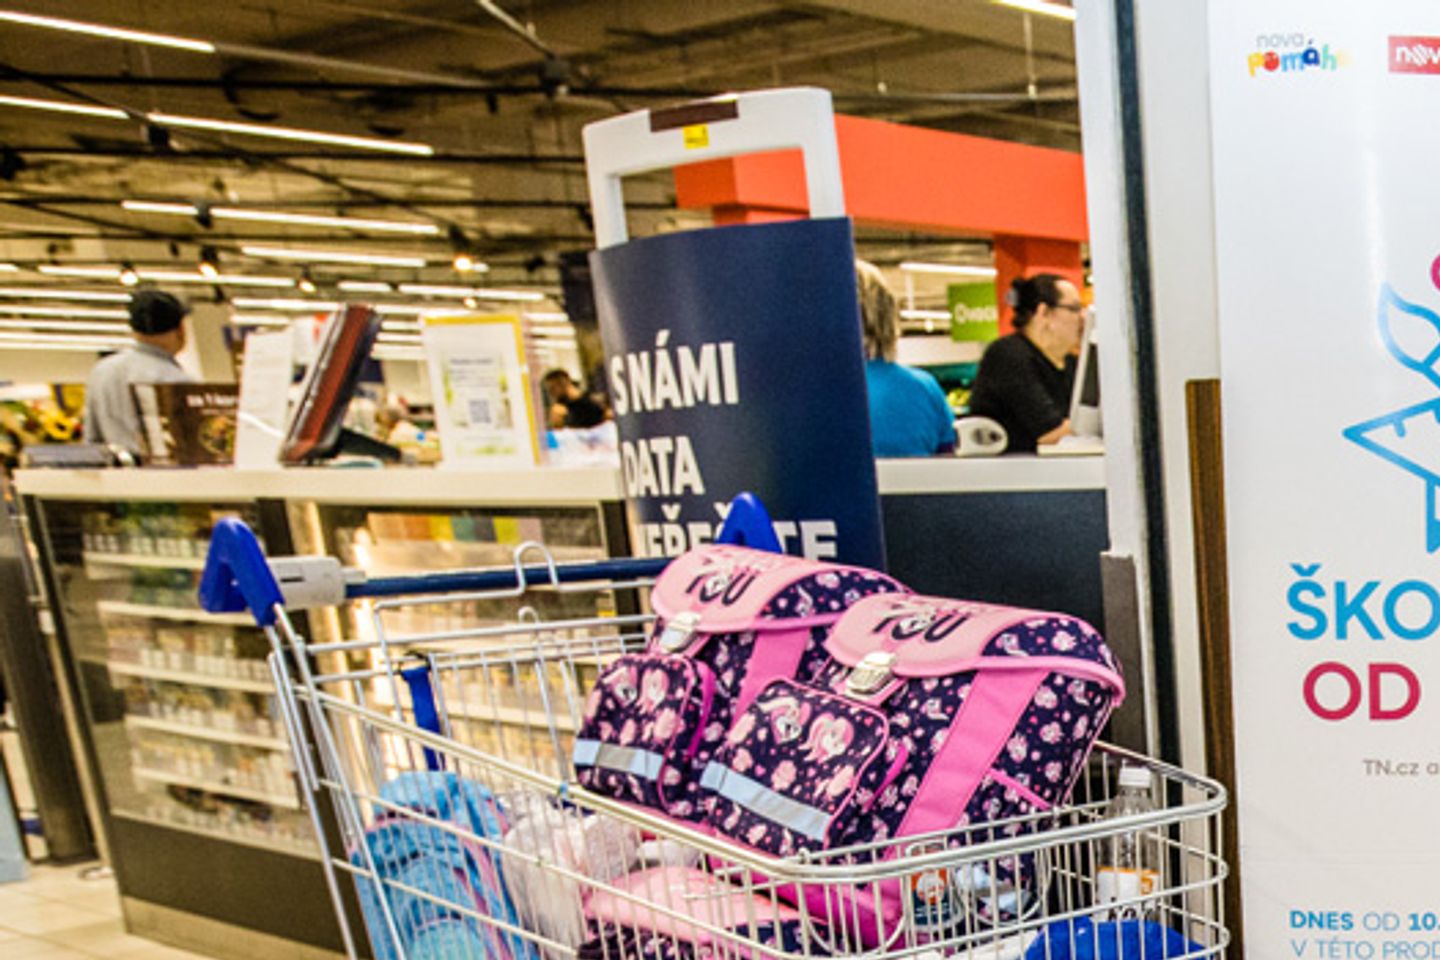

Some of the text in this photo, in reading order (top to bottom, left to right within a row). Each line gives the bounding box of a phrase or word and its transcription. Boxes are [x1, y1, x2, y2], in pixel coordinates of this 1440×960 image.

[622, 436, 706, 497] DATA
[1302, 661, 1422, 721] OD
[1363, 758, 1420, 777] TN.cz
[1426, 762, 1440, 776] a
[1289, 910, 1354, 931] DNES
[1362, 912, 1400, 931] OD
[1291, 939, 1306, 958] V
[1315, 935, 1374, 960] TÉTO
